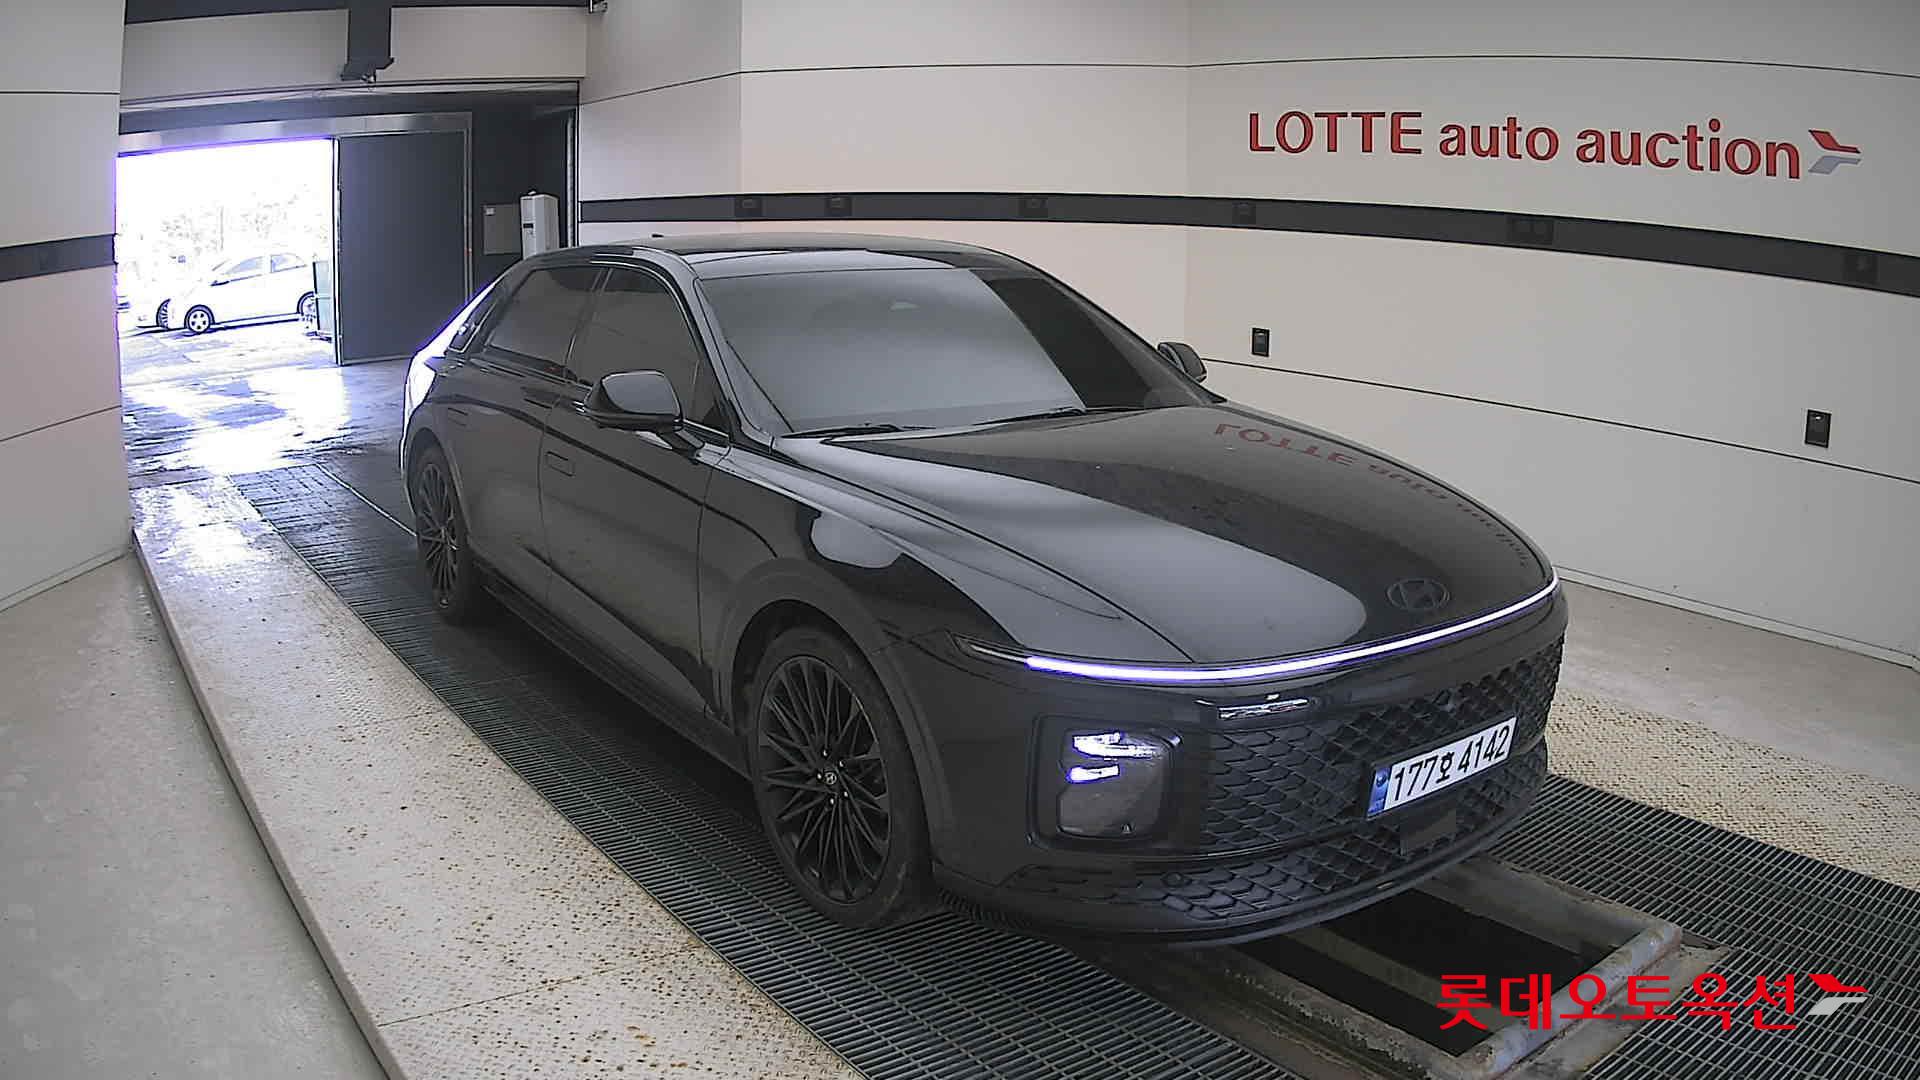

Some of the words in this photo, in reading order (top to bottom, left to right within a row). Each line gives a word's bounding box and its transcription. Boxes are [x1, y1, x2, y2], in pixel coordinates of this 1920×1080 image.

[1248, 111, 1423, 154] LOTTE
[1439, 117, 1560, 161] auto
[1576, 118, 1801, 179] auction
[1394, 751, 1455, 801] 177호
[1457, 725, 1510, 774] 4142
